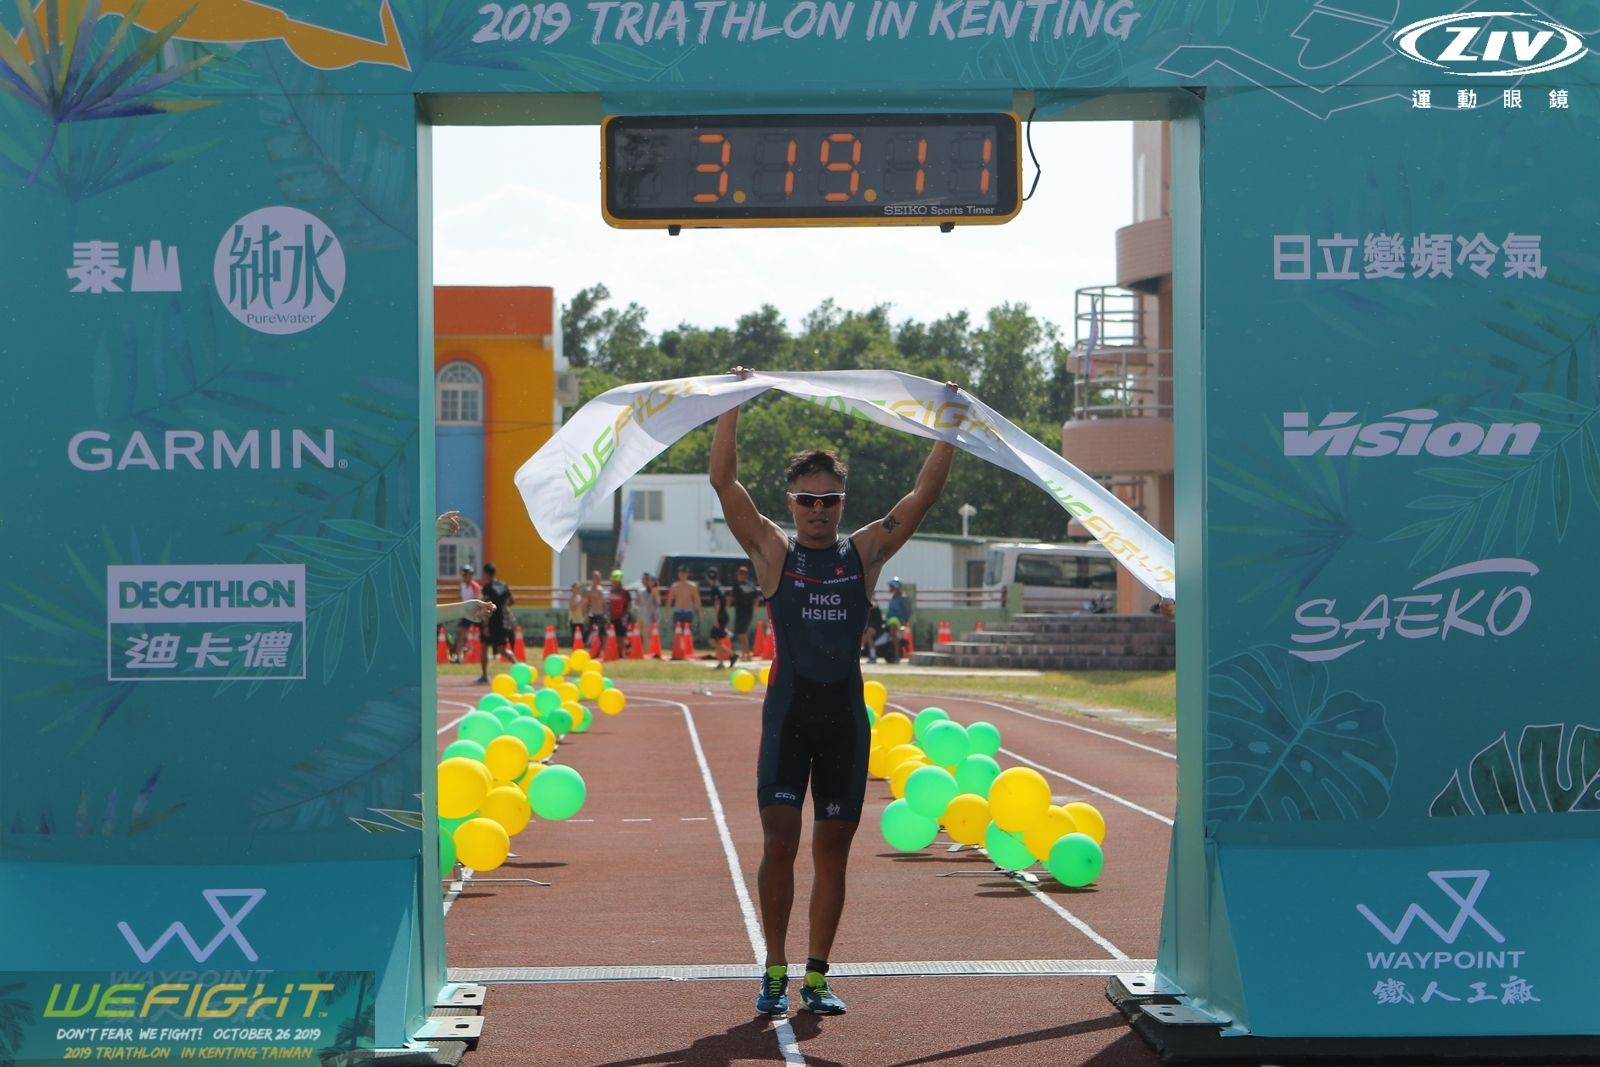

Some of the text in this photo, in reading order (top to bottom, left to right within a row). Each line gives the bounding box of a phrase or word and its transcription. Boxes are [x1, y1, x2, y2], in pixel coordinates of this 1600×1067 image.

[472, 0, 1142, 46] 2019 TRIATHLON IN KENTING
[884, 205, 995, 216] SEIKO Sports Timer
[66, 240, 182, 293] 泰山
[228, 224, 337, 311] 純水
[1273, 232, 1548, 280] 日立變頻冷氣
[247, 313, 316, 325] PureWater
[118, 580, 296, 609] DECATHLON
[809, 593, 841, 606] HKG
[802, 607, 847, 620] HSIEH
[1291, 585, 1532, 643] SAEKO
[125, 632, 293, 669] 迪卡儂
[1366, 951, 1525, 970] WAYPOINT
